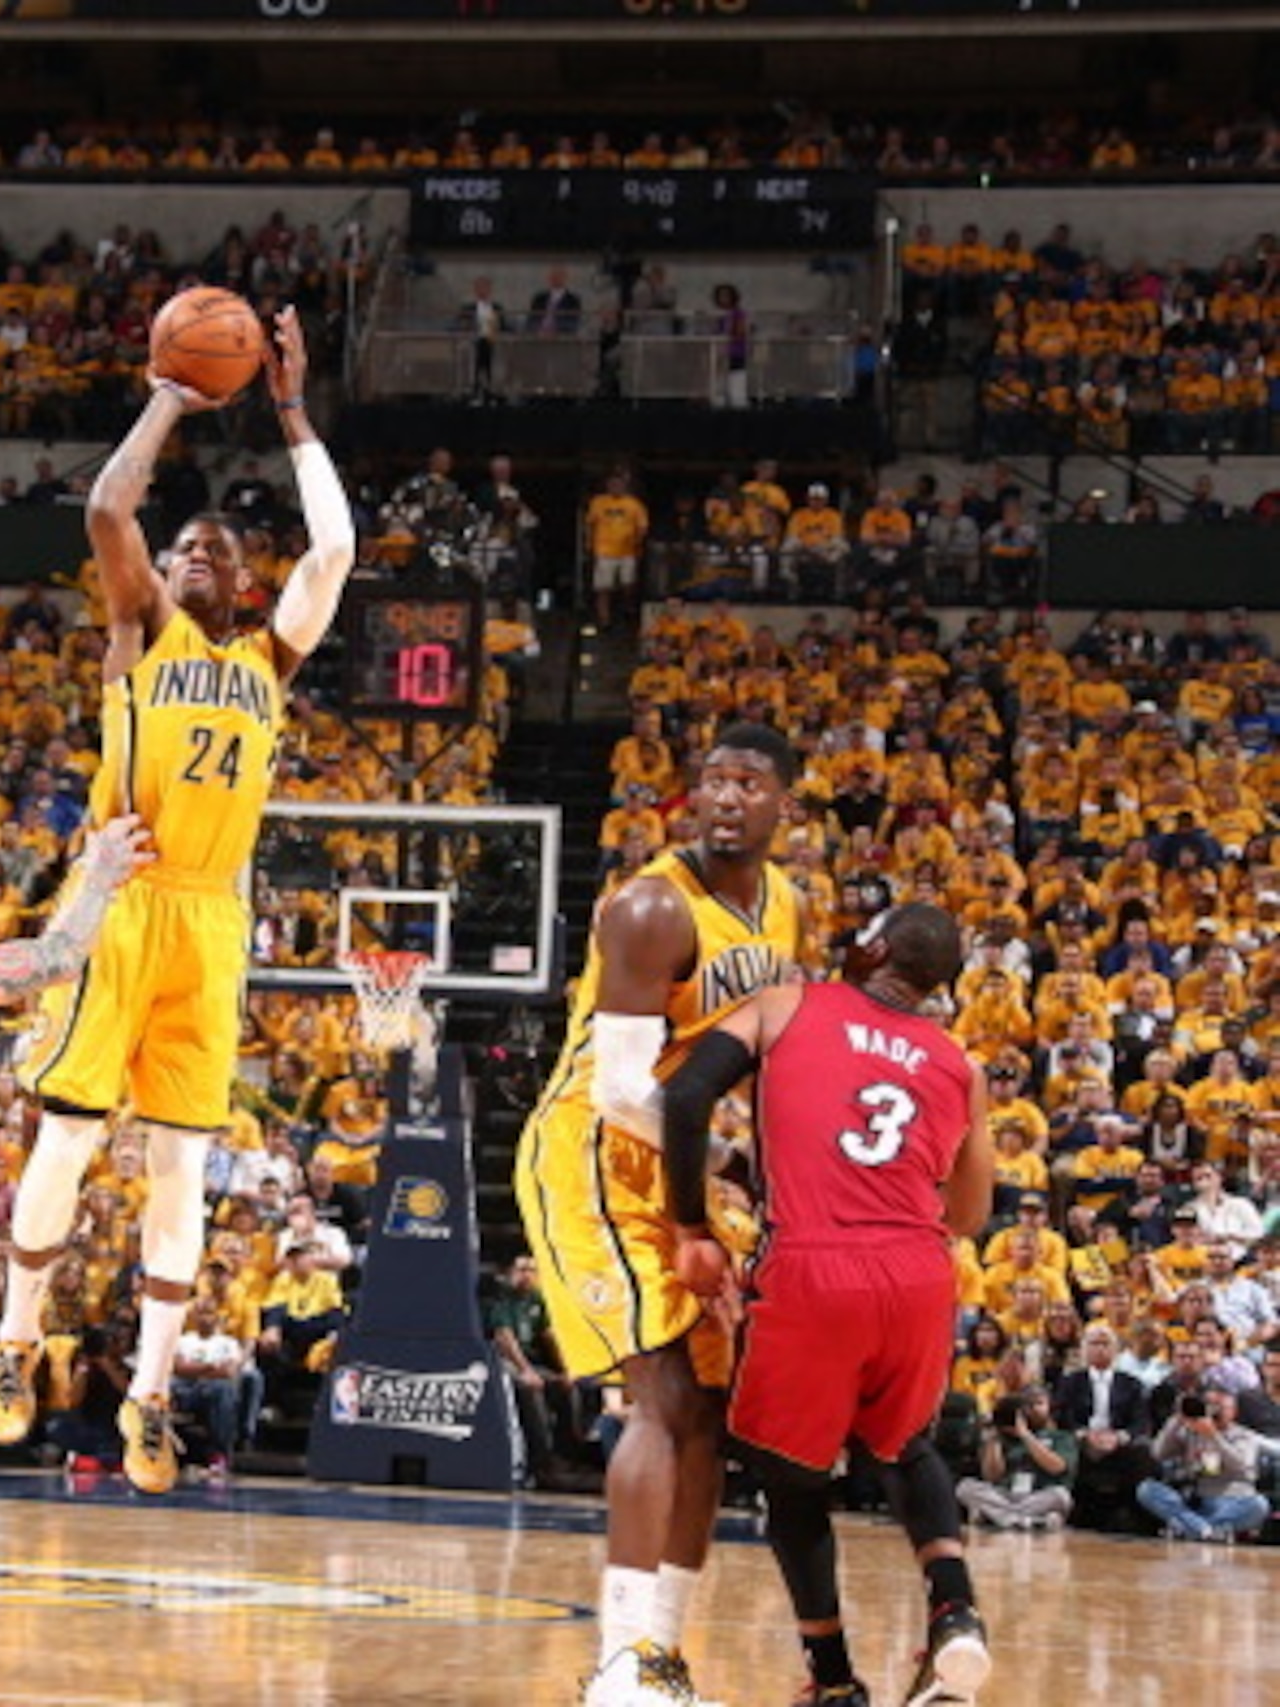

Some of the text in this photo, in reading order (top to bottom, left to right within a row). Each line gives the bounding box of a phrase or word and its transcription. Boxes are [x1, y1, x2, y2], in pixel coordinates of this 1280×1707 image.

[398, 643, 452, 706] 10
[181, 726, 241, 790] 24
[844, 1021, 928, 1075] WADE
[837, 1082, 919, 1168] 3
[361, 1373, 484, 1404] EASTERN
